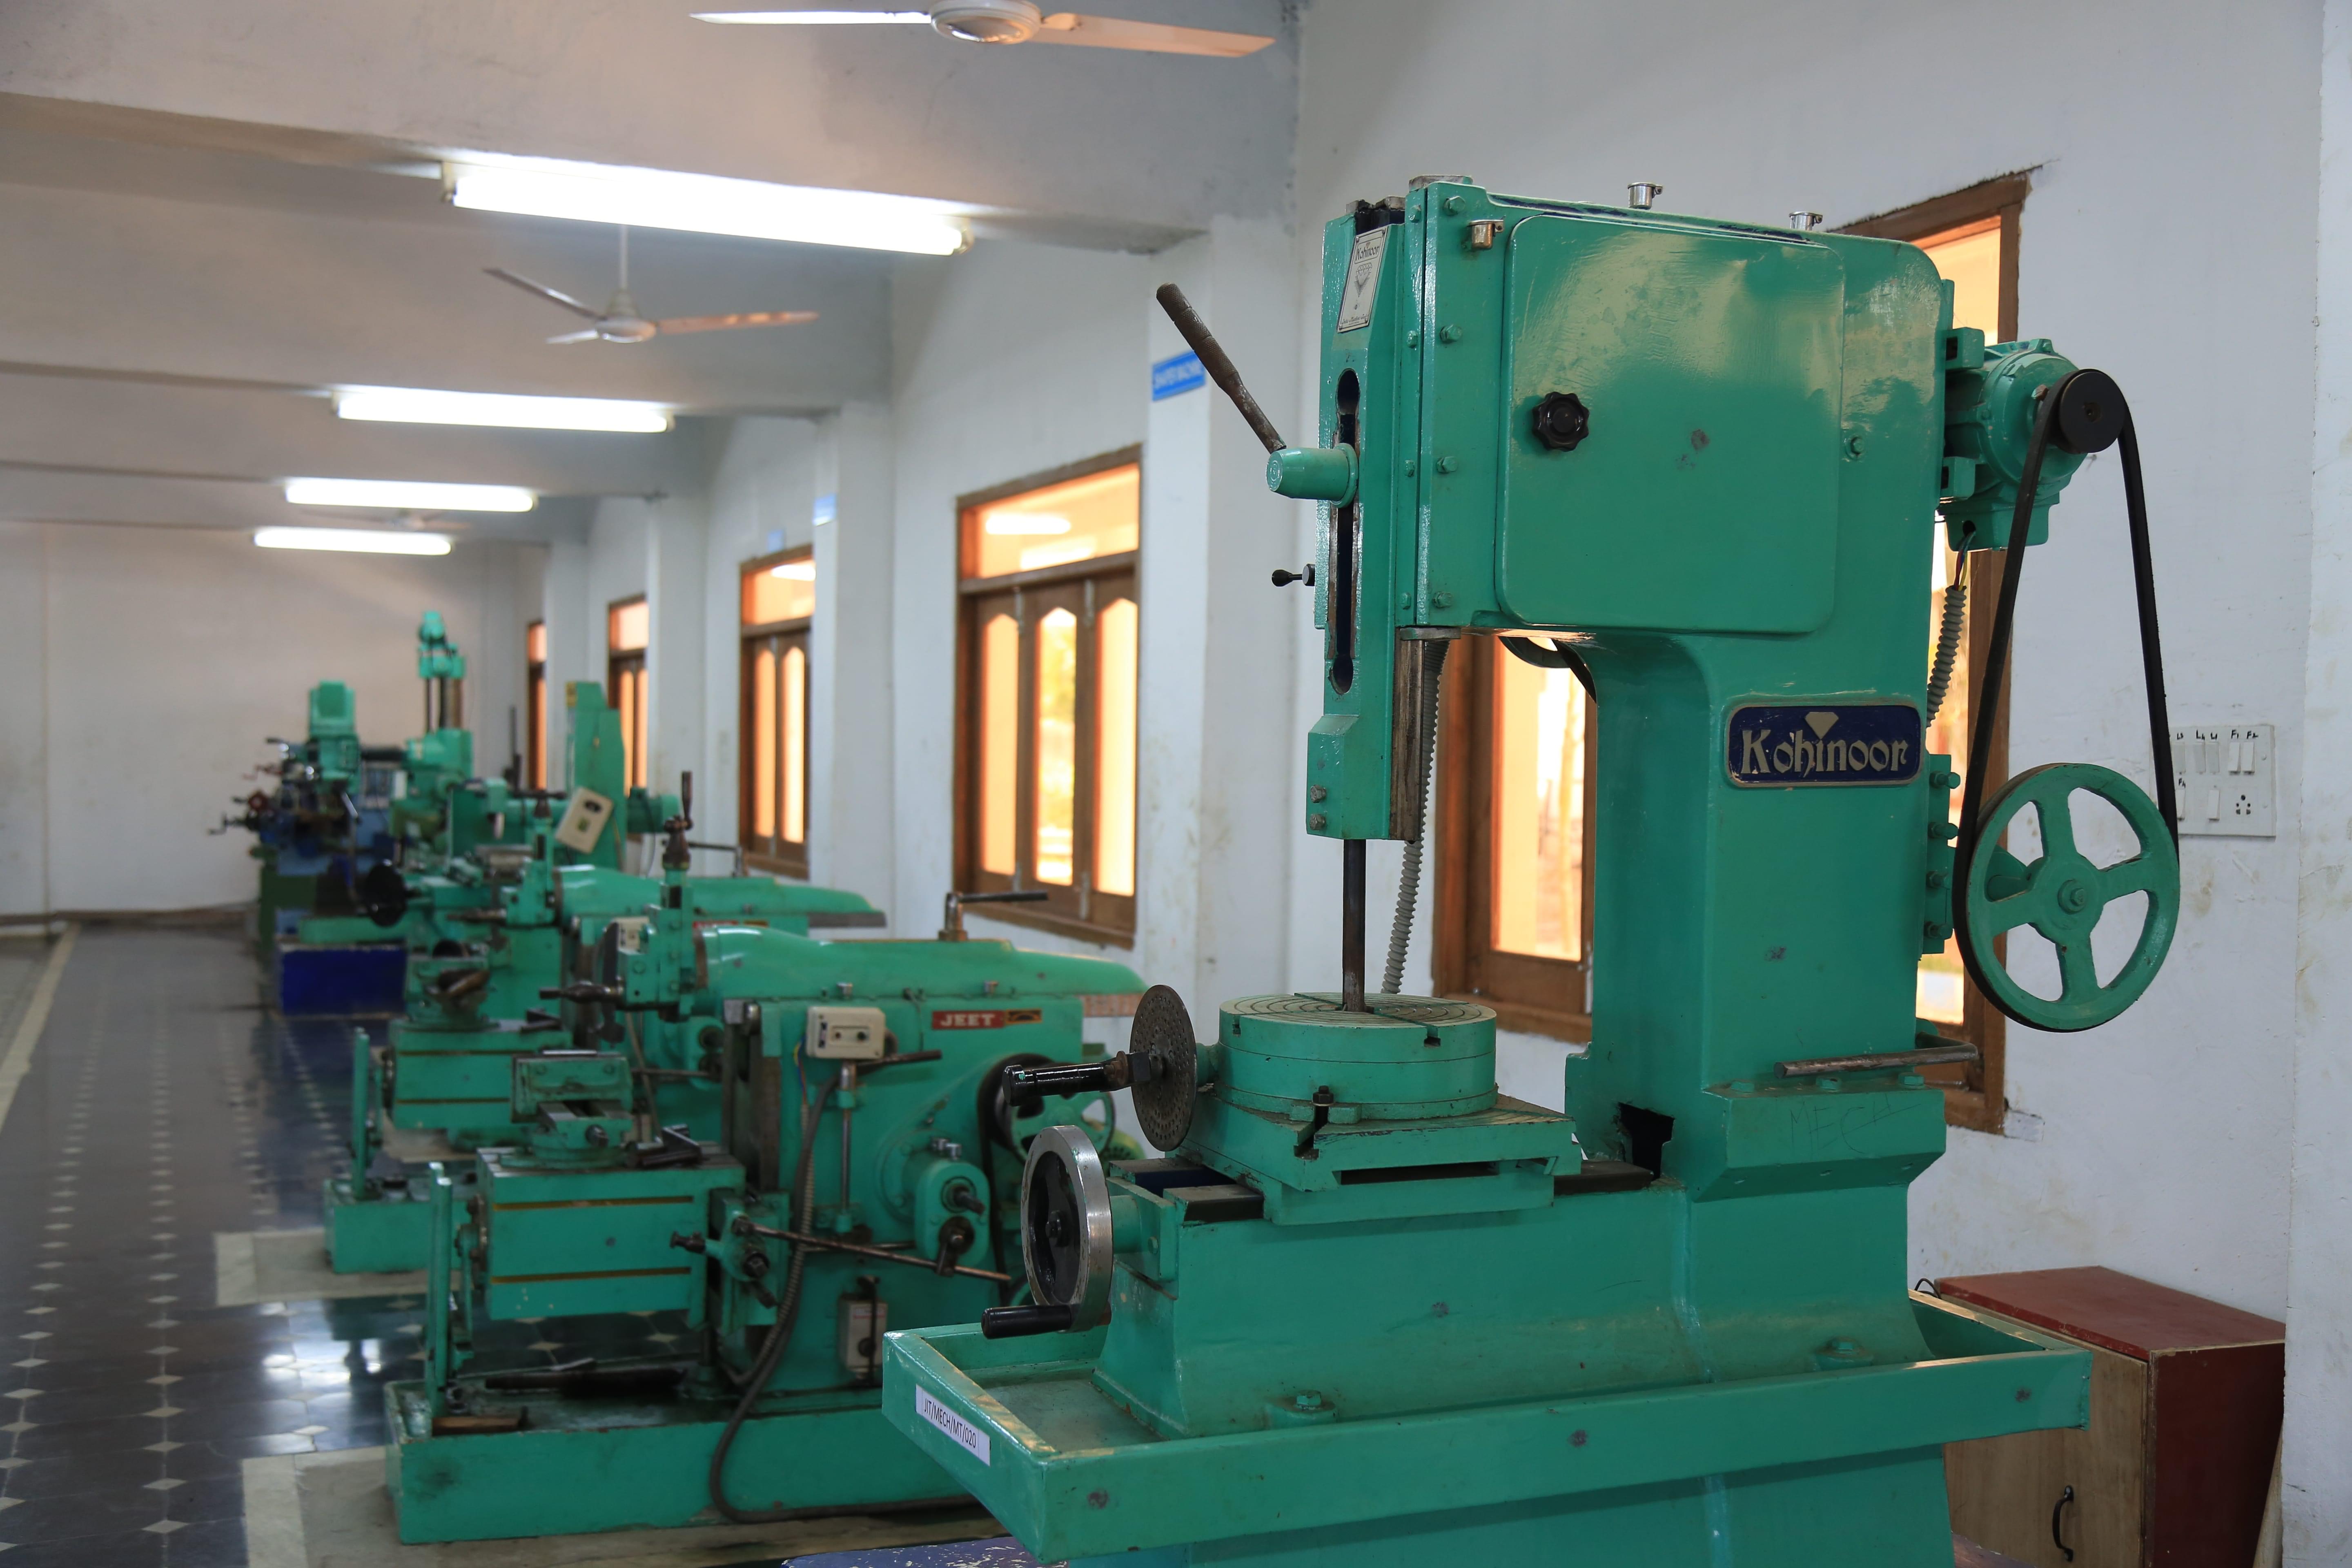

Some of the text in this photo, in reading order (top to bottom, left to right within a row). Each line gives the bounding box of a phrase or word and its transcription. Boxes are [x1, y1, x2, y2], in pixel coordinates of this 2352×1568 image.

[1355, 246, 1380, 261] Kohinoor
[2231, 729, 2238, 739] F1
[2247, 731, 2258, 739] F2
[1741, 730, 1908, 777] Kohinoor
[940, 1013, 995, 1026] JEET
[924, 1398, 976, 1448] JIT/MECH/MT/020
